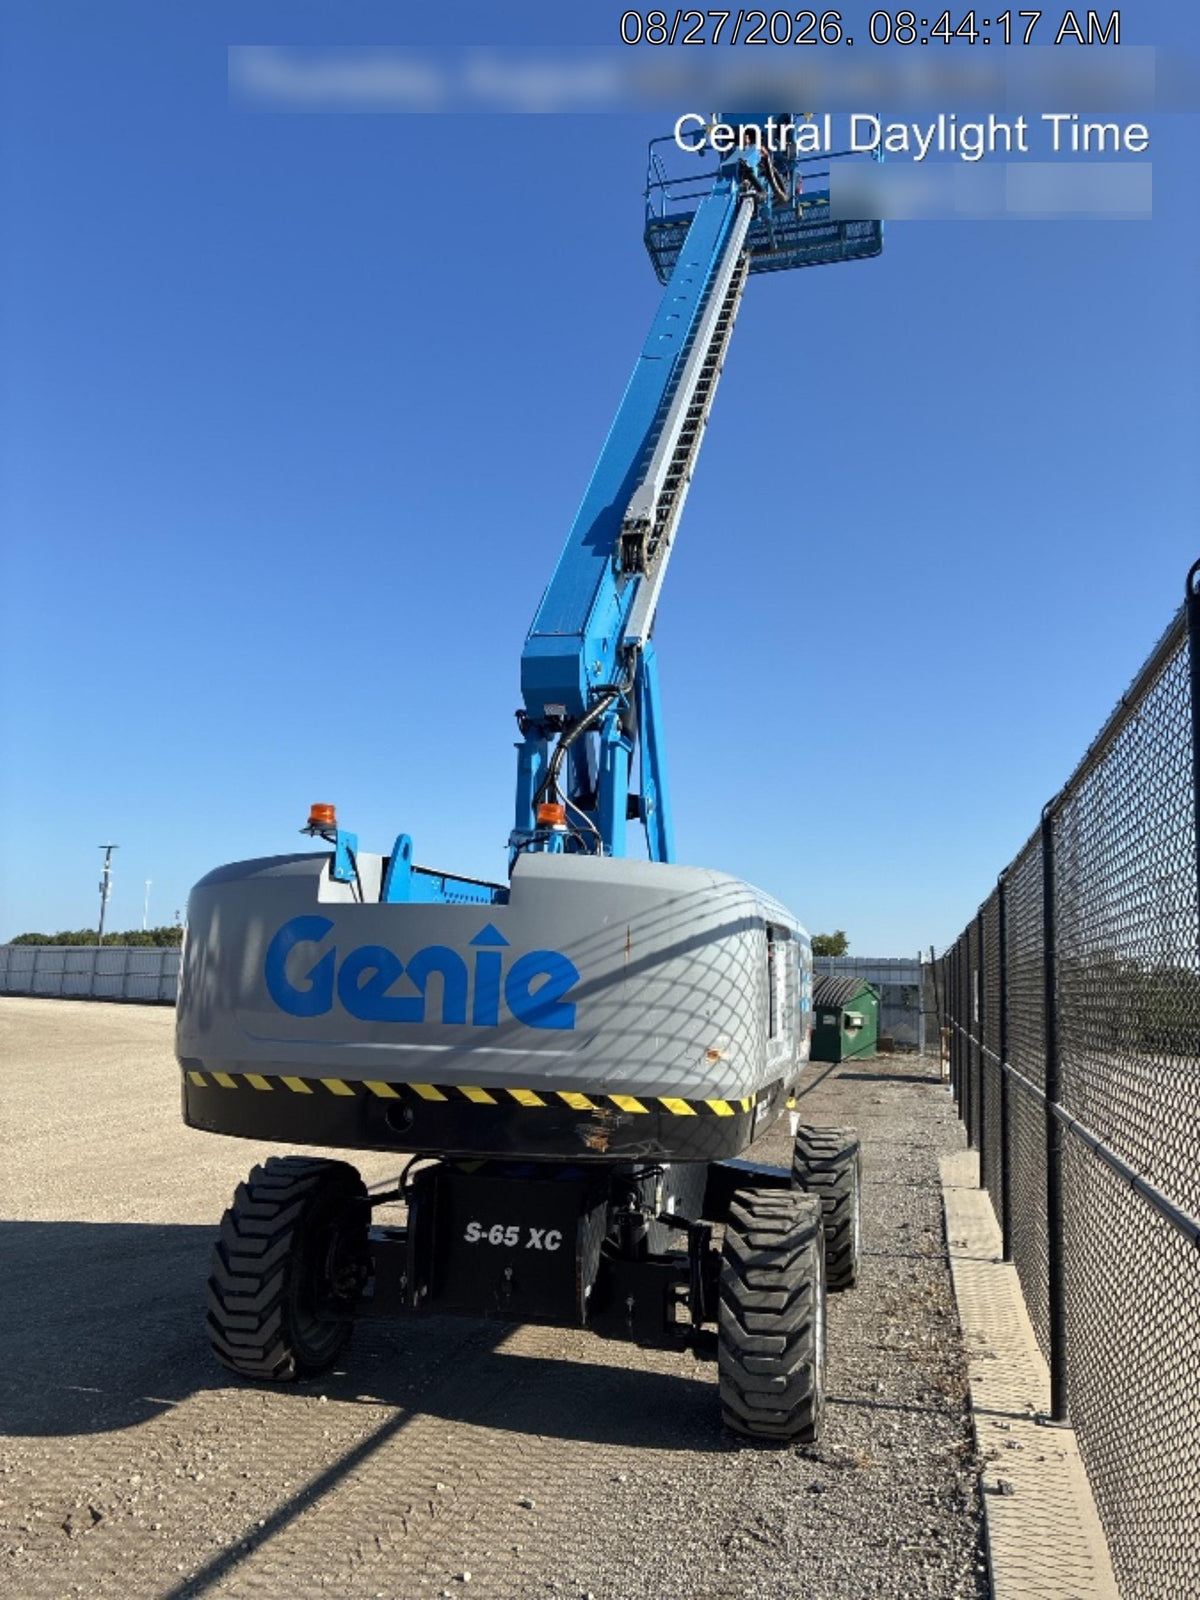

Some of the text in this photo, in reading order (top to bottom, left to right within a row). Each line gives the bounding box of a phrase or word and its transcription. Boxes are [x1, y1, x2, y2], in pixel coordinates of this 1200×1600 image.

[264, 915, 581, 1030] Genie
[464, 1222, 563, 1251] S-65 XC
